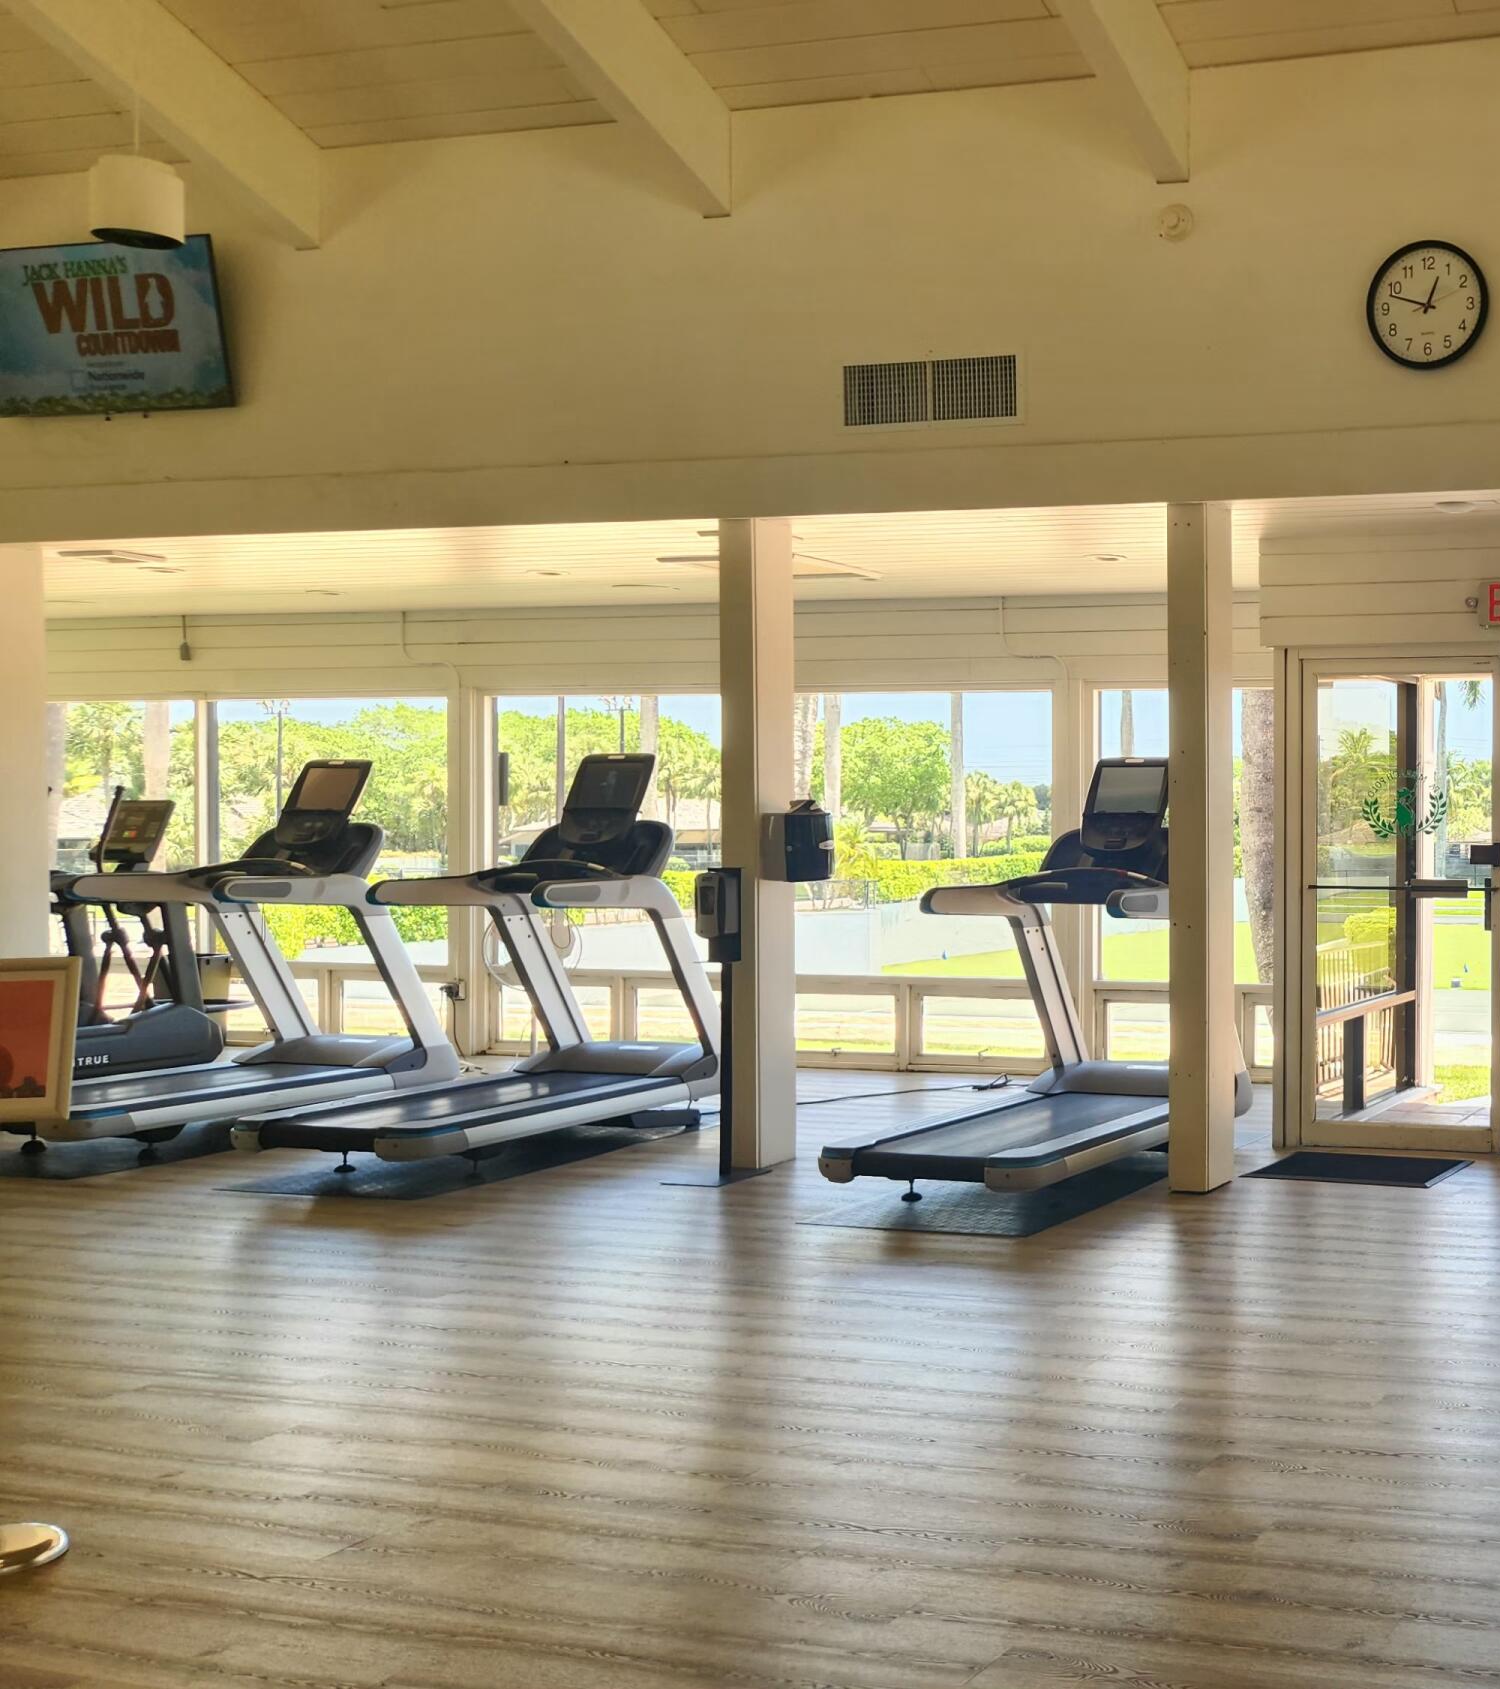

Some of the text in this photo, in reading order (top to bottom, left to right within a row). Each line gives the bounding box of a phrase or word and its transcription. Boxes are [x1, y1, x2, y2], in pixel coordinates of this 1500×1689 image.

[1421, 256, 1436, 270] 12
[22, 255, 128, 287] JACK HANNA'S
[1402, 265, 1413, 279] 11
[1388, 281, 1402, 295] 10
[1459, 274, 1468, 288] 2
[31, 271, 175, 335] WILD
[1381, 302, 1390, 316] 9
[1466, 296, 1475, 310] 3
[1388, 323, 1397, 337] 8
[1458, 319, 1467, 332] 4
[1404, 337, 1413, 351] 7
[1443, 335, 1452, 348] 5
[1423, 342, 1432, 356] 6
[77, 1054, 110, 1066] TRUE
